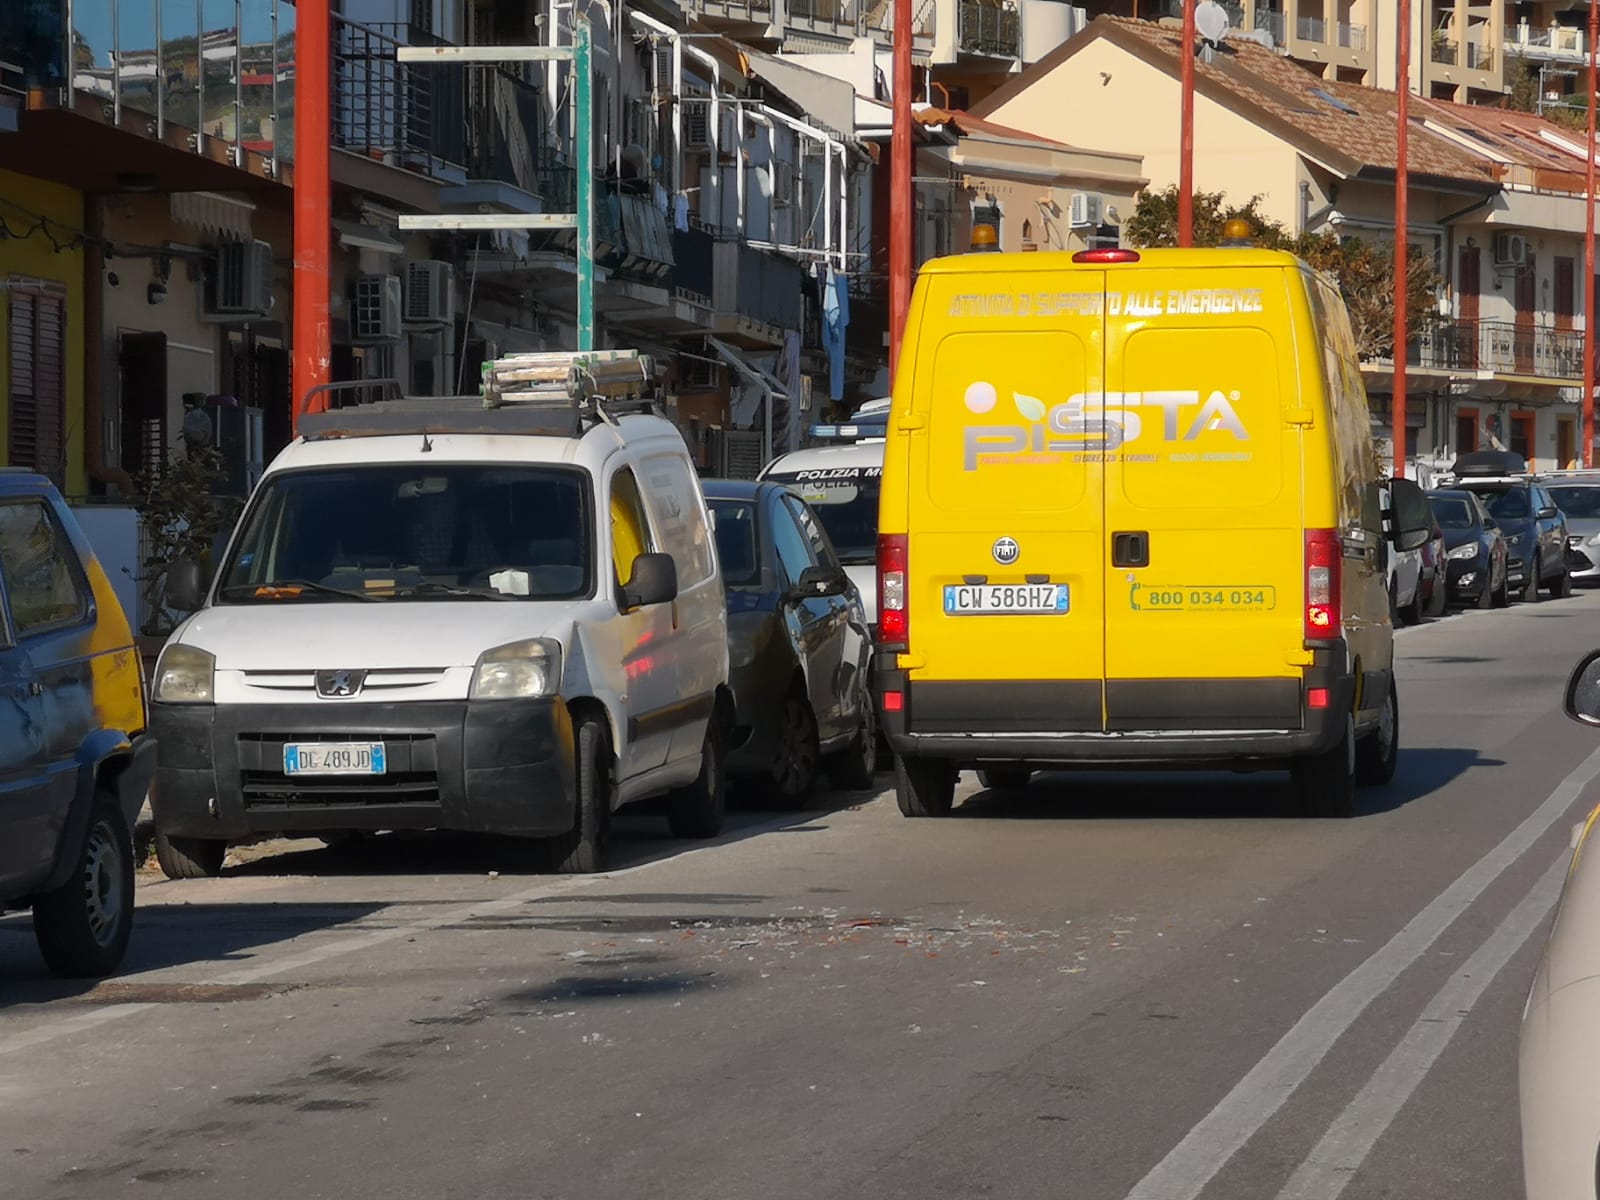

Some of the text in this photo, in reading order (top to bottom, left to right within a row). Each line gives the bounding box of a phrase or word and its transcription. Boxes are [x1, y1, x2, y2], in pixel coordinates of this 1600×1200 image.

[1124, 290, 1164, 316] ALLE
[1166, 288, 1264, 313] EMERGENZE
[796, 468, 859, 480] POLIZIA
[996, 545, 1016, 556] FIAT
[959, 587, 1055, 608] CW 586HZ
[1150, 591, 1265, 605] 800 034 034
